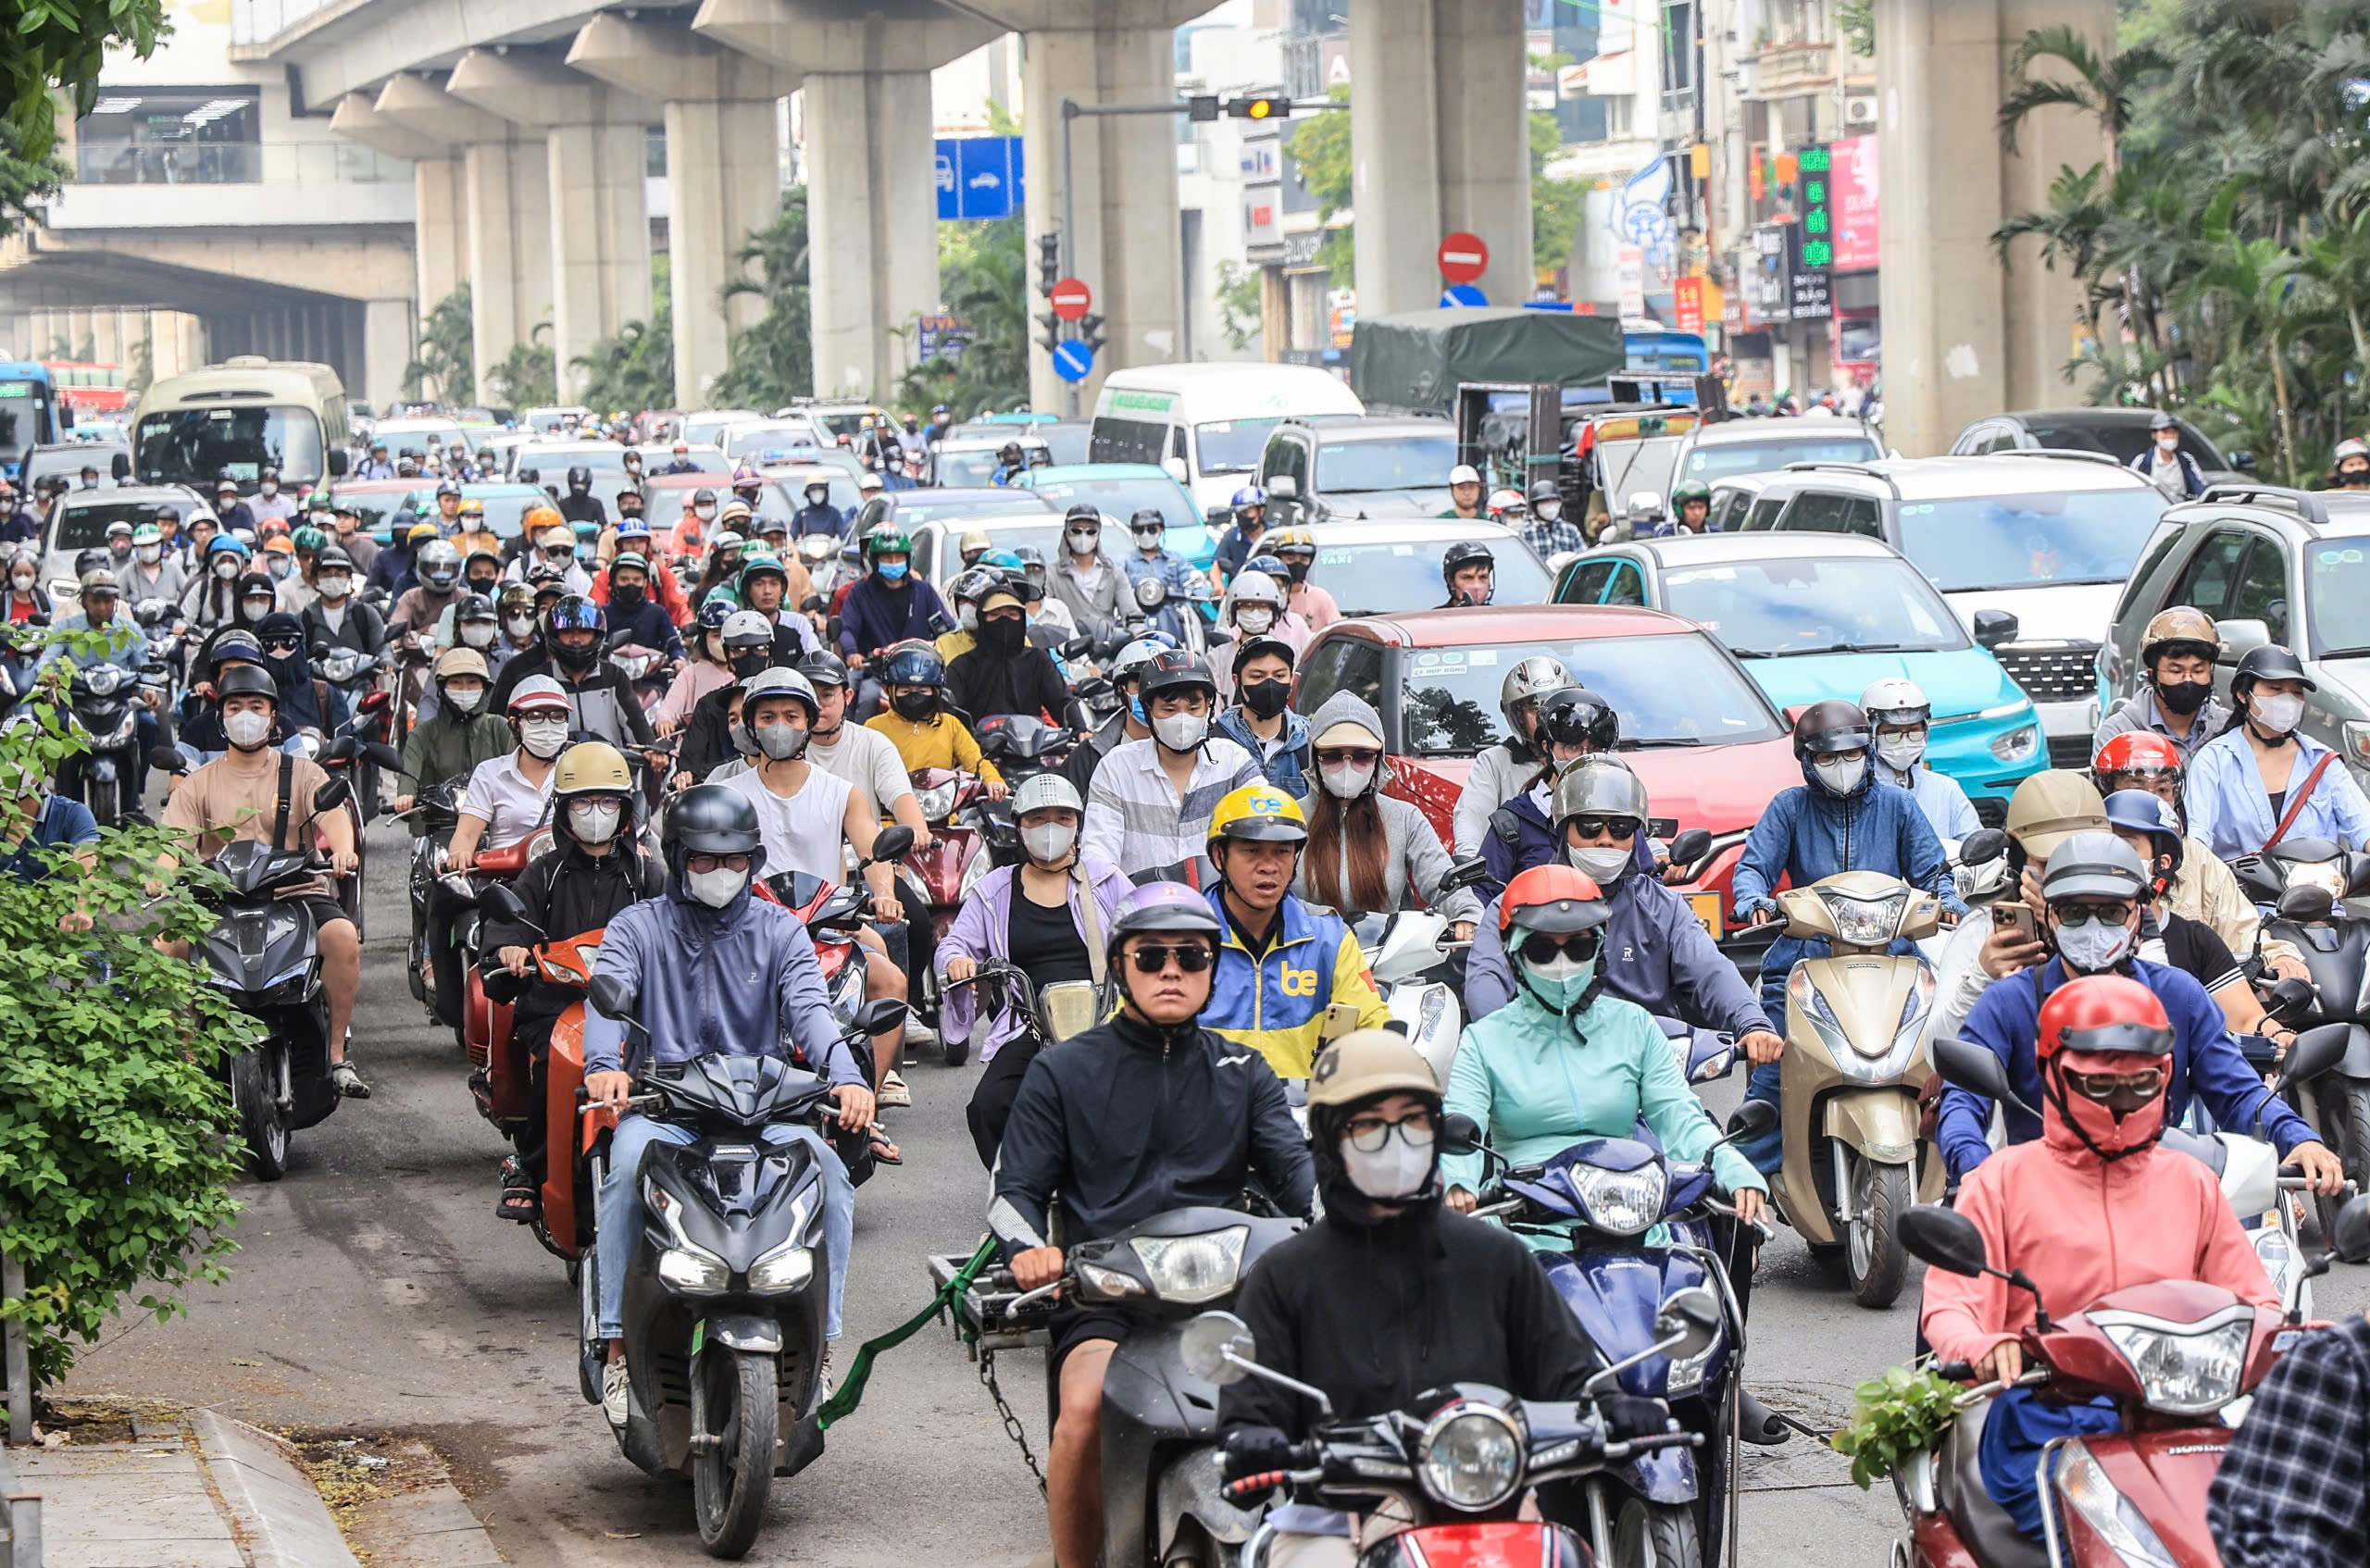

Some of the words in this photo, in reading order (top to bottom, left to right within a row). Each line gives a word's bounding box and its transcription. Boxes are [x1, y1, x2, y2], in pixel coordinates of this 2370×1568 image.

[1320, 554, 1353, 566] TAXI
[1249, 795, 1283, 814] be
[1280, 960, 1319, 997] be
[2169, 1445, 2226, 1455] HONDA
